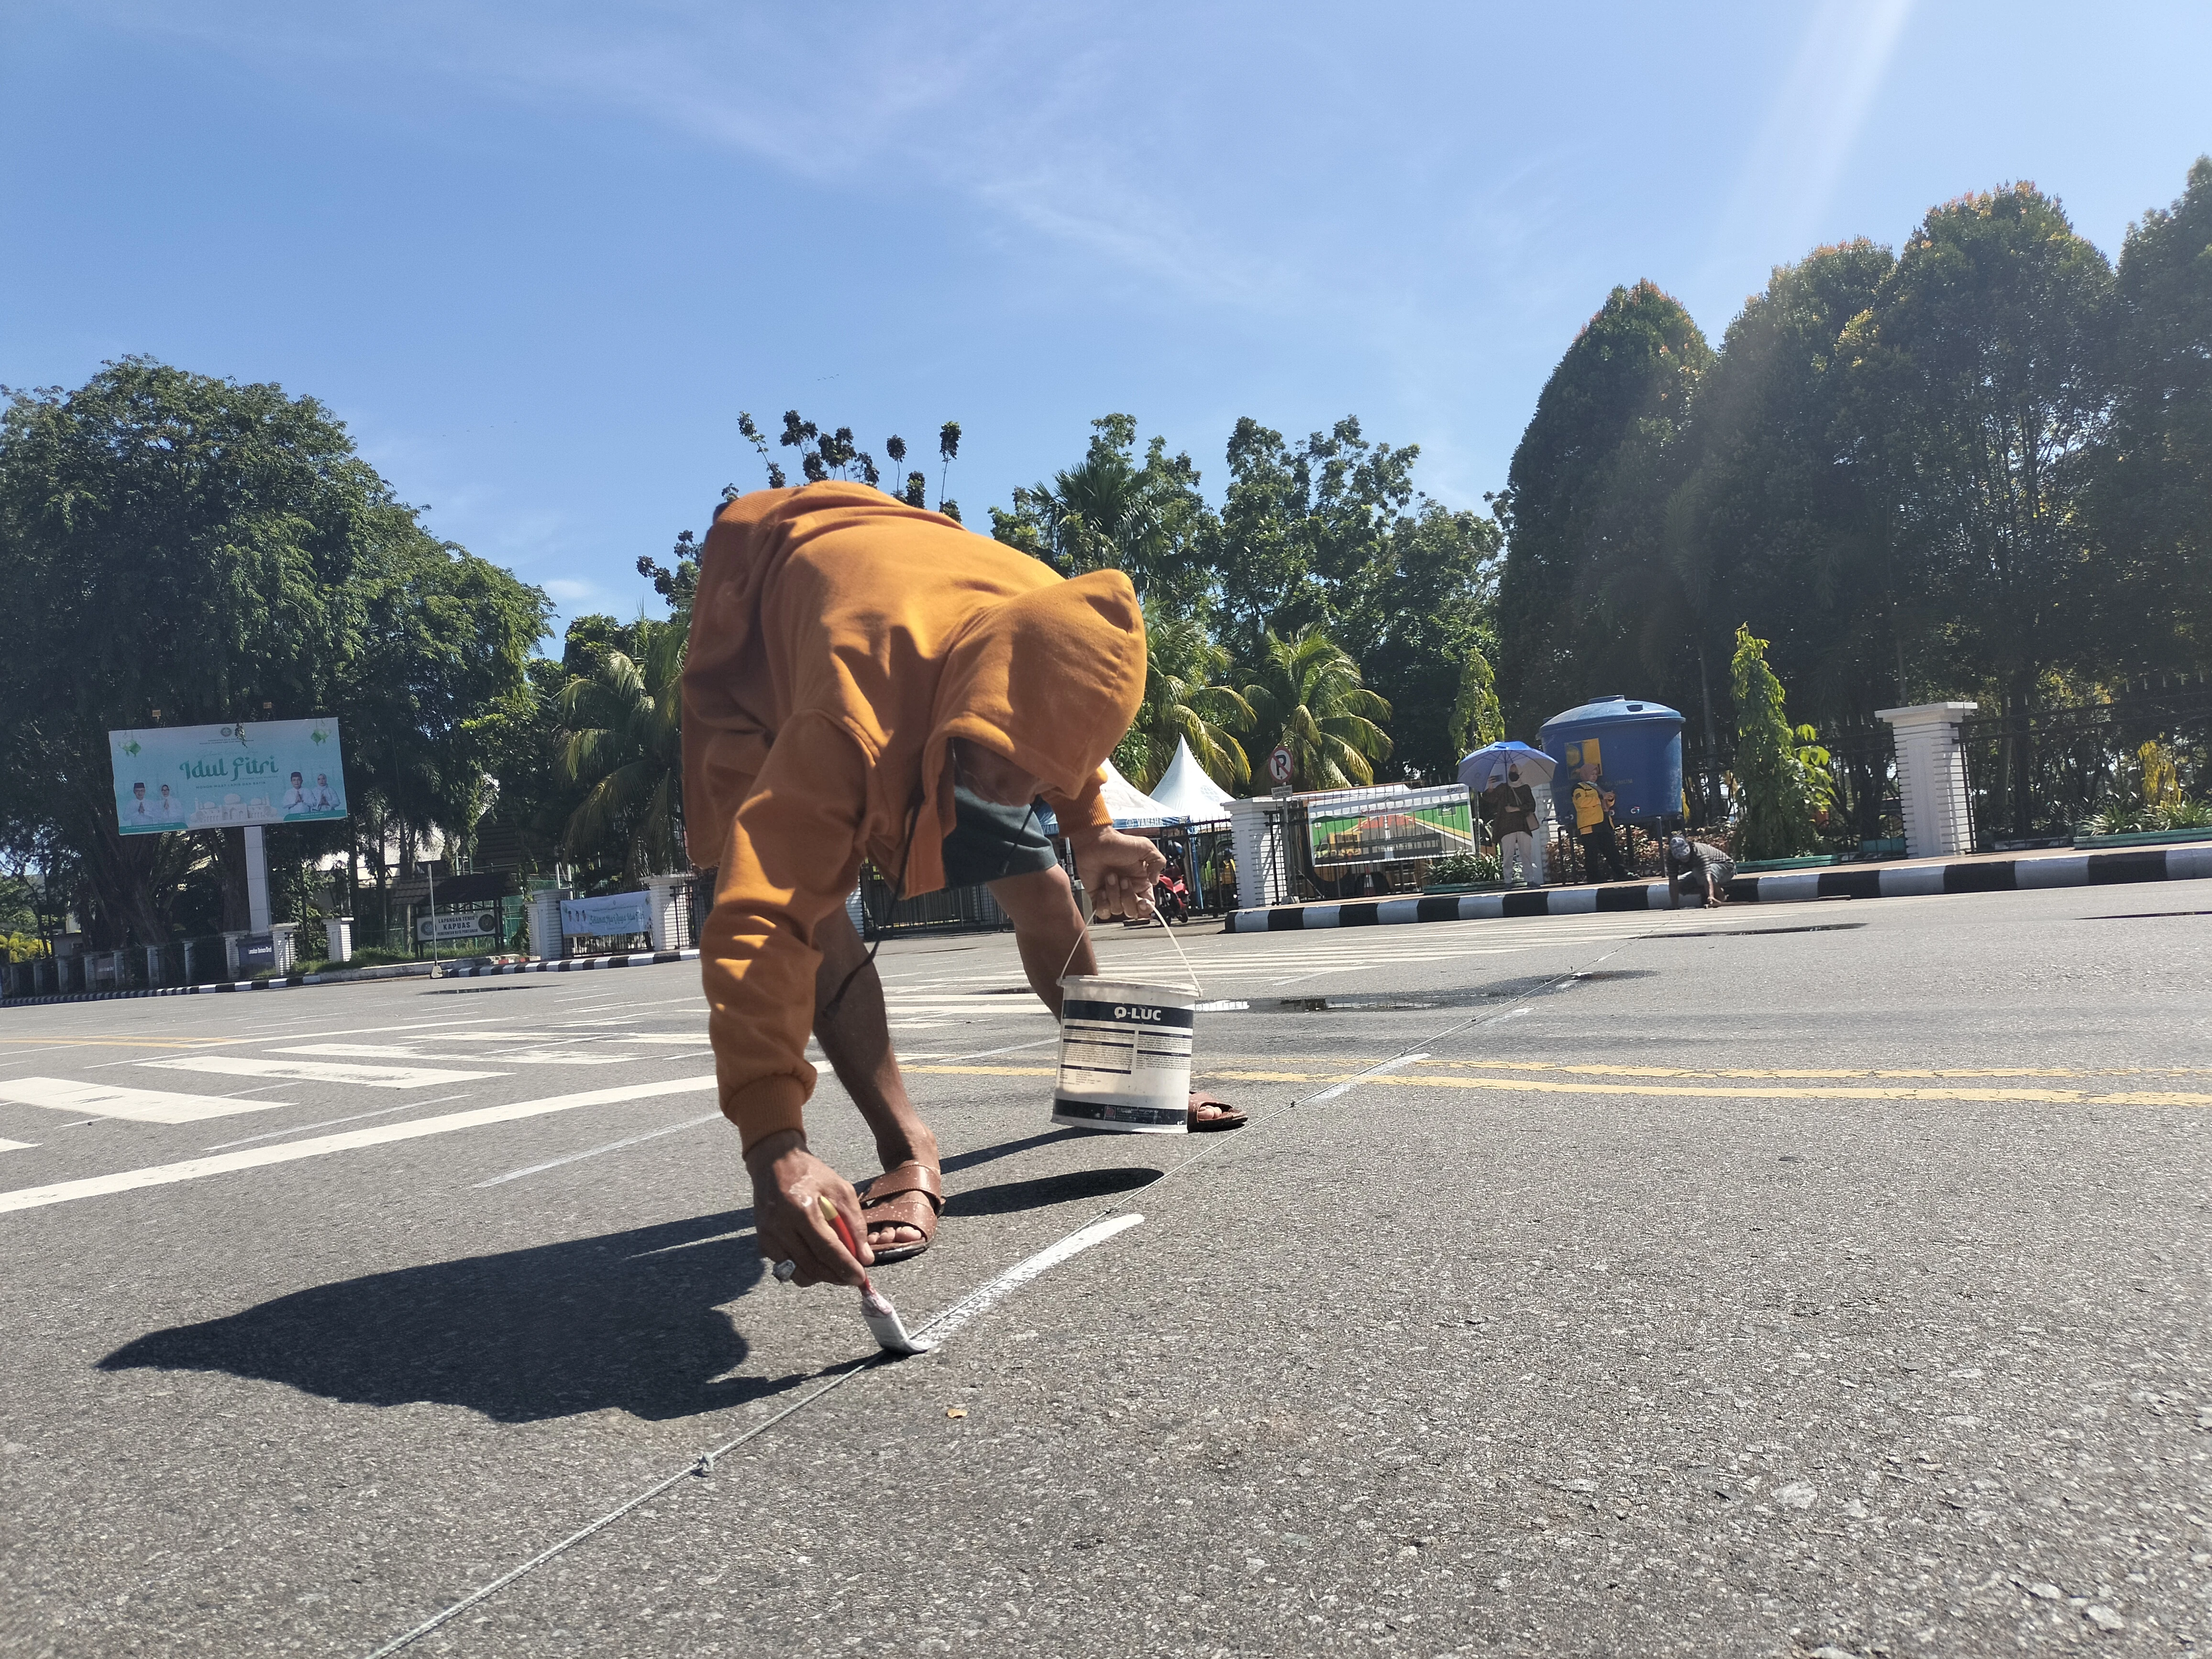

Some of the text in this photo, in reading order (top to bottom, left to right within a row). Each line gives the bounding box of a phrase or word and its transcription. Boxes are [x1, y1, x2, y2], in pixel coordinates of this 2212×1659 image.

[179, 755, 279, 782] Idul Fitri
[1276, 754, 1287, 775] P
[1137, 817, 1164, 827] YAMAHA
[443, 922, 471, 930] KAPUAS
[1114, 1006, 1161, 1021] Q-LUC
